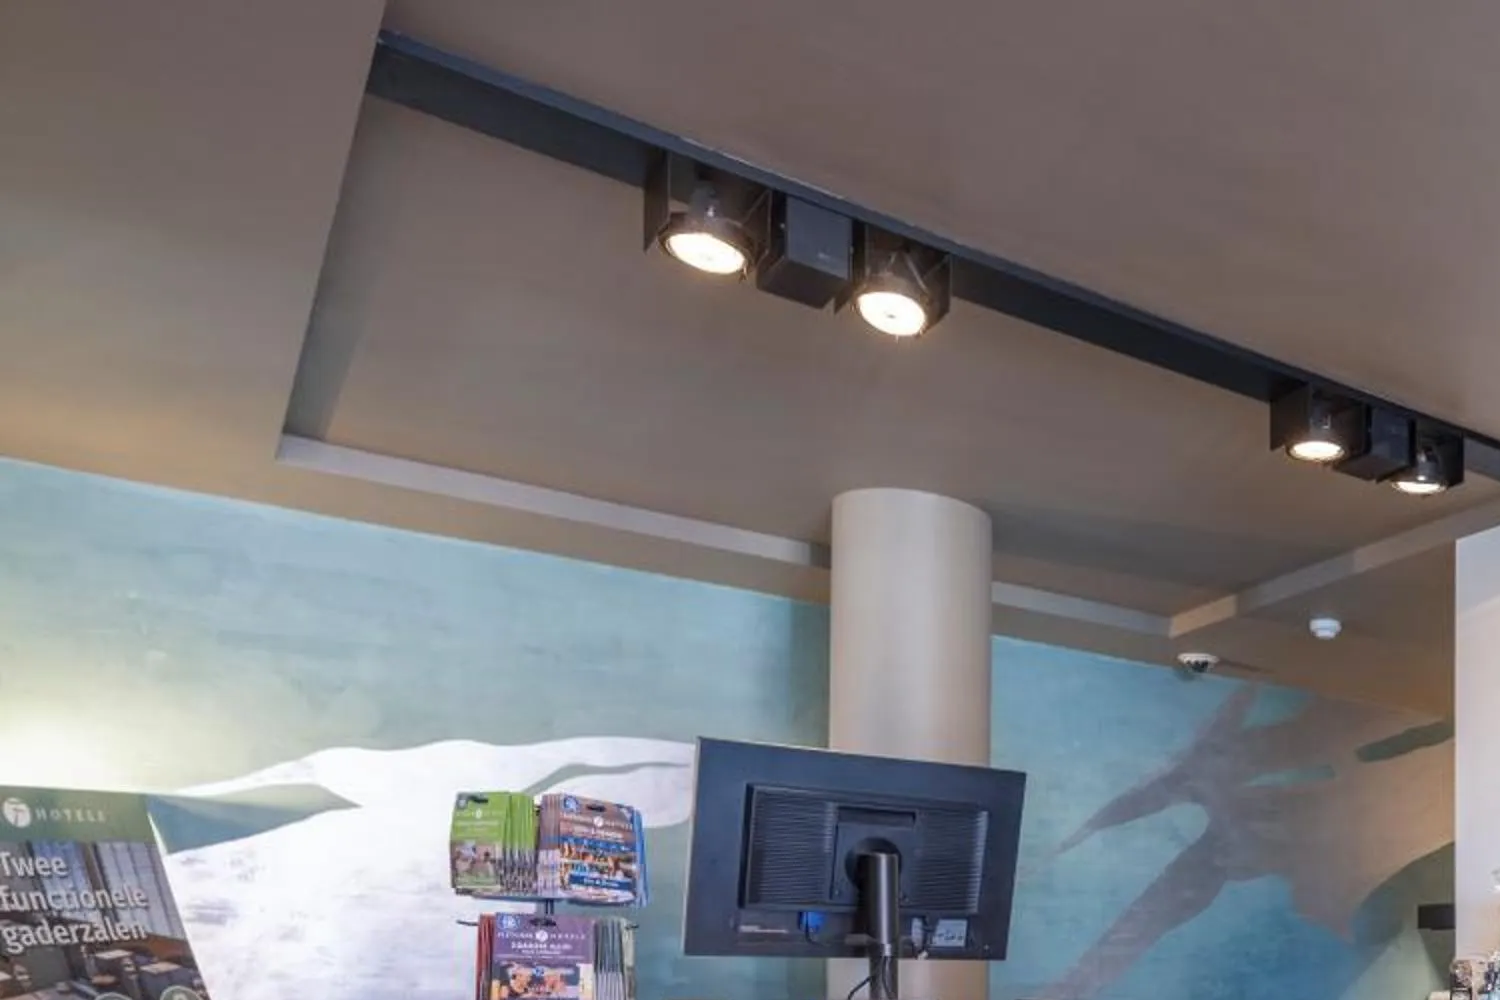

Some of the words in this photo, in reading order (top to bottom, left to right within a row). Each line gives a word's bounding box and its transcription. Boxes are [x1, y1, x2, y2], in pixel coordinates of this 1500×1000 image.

[0, 851, 70, 878] Twee
[0, 882, 150, 912] functionele
[1, 914, 149, 955] gaderzalen
